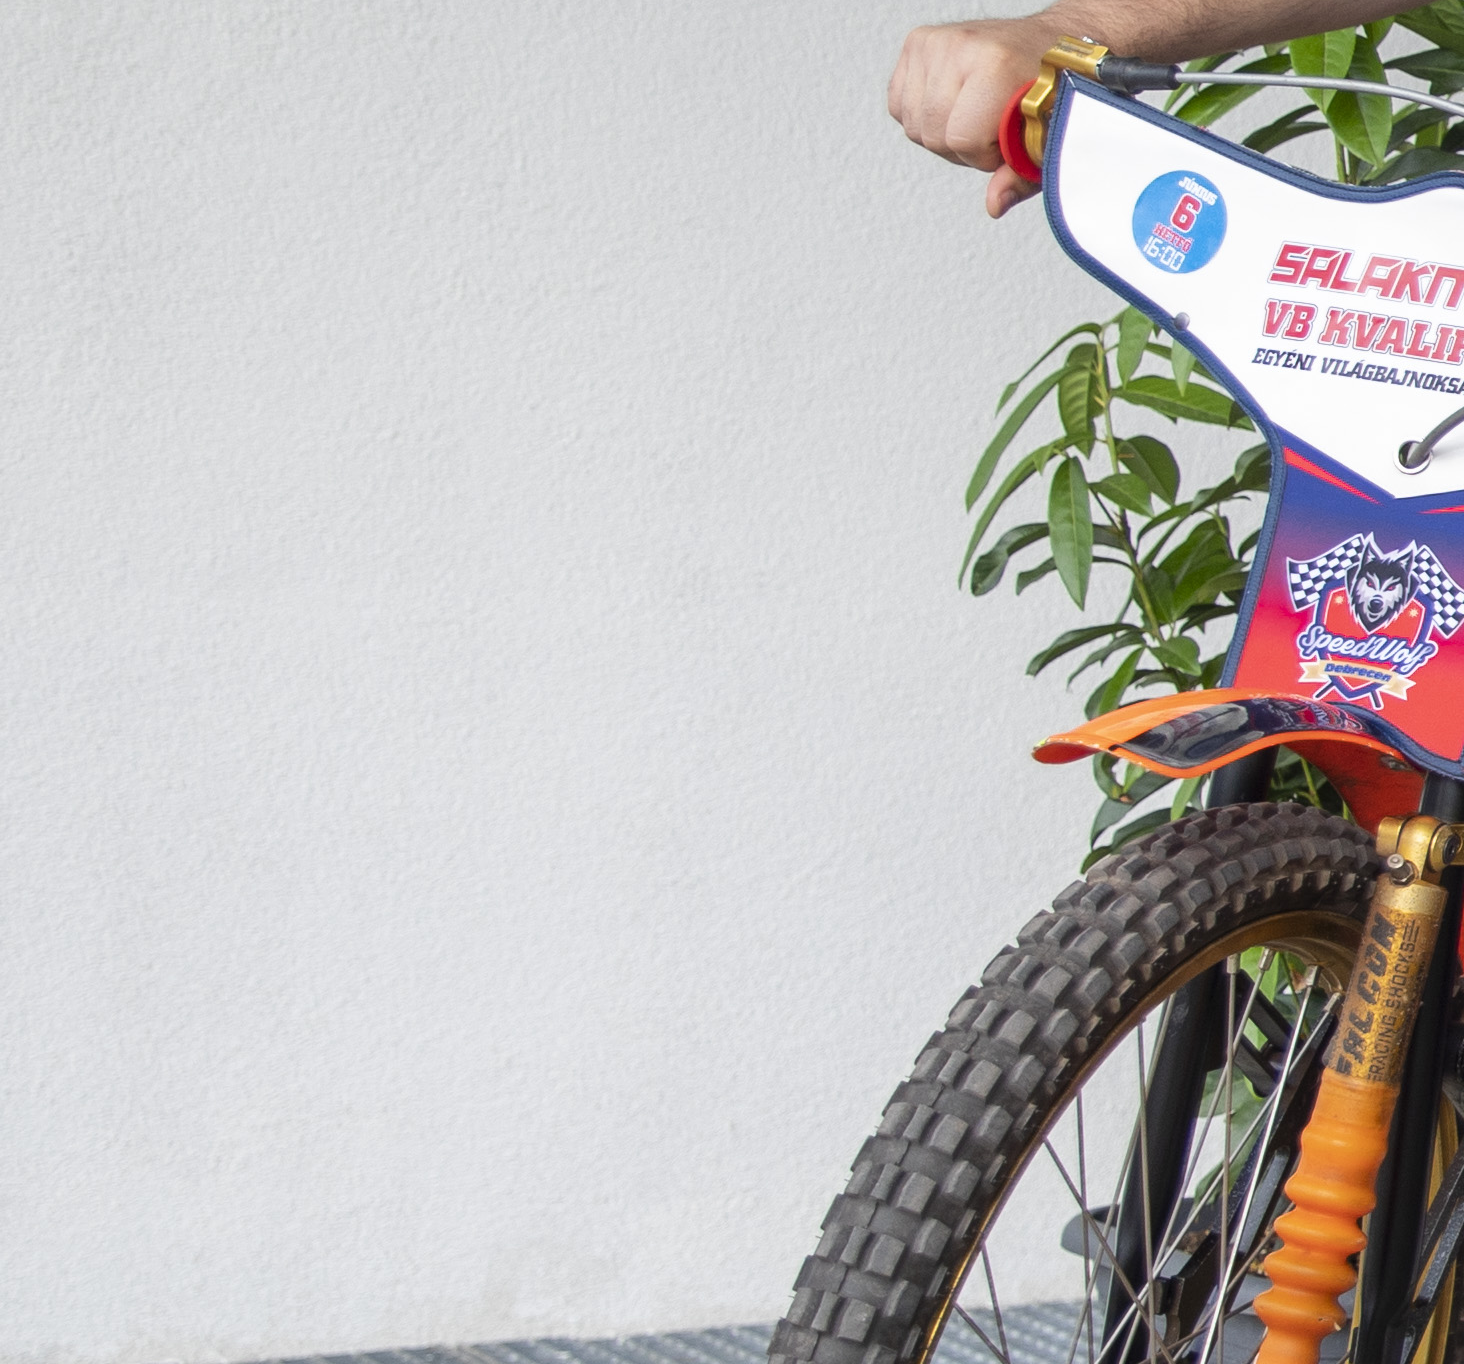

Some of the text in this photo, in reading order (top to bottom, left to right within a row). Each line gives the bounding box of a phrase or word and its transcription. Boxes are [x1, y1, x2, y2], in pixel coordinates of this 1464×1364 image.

[1178, 176, 1218, 206] JÚNIUS
[1170, 192, 1203, 233] 6
[1143, 236, 1186, 271] 16:00
[1264, 300, 1317, 339] VB
[1252, 348, 1317, 372] EGYÉNI
[1301, 625, 1436, 673] SpeedWolf
[1324, 662, 1392, 683] Debrecen
[1335, 911, 1396, 1076] FALCON
[1369, 941, 1416, 1076] RACING SHOCKS
